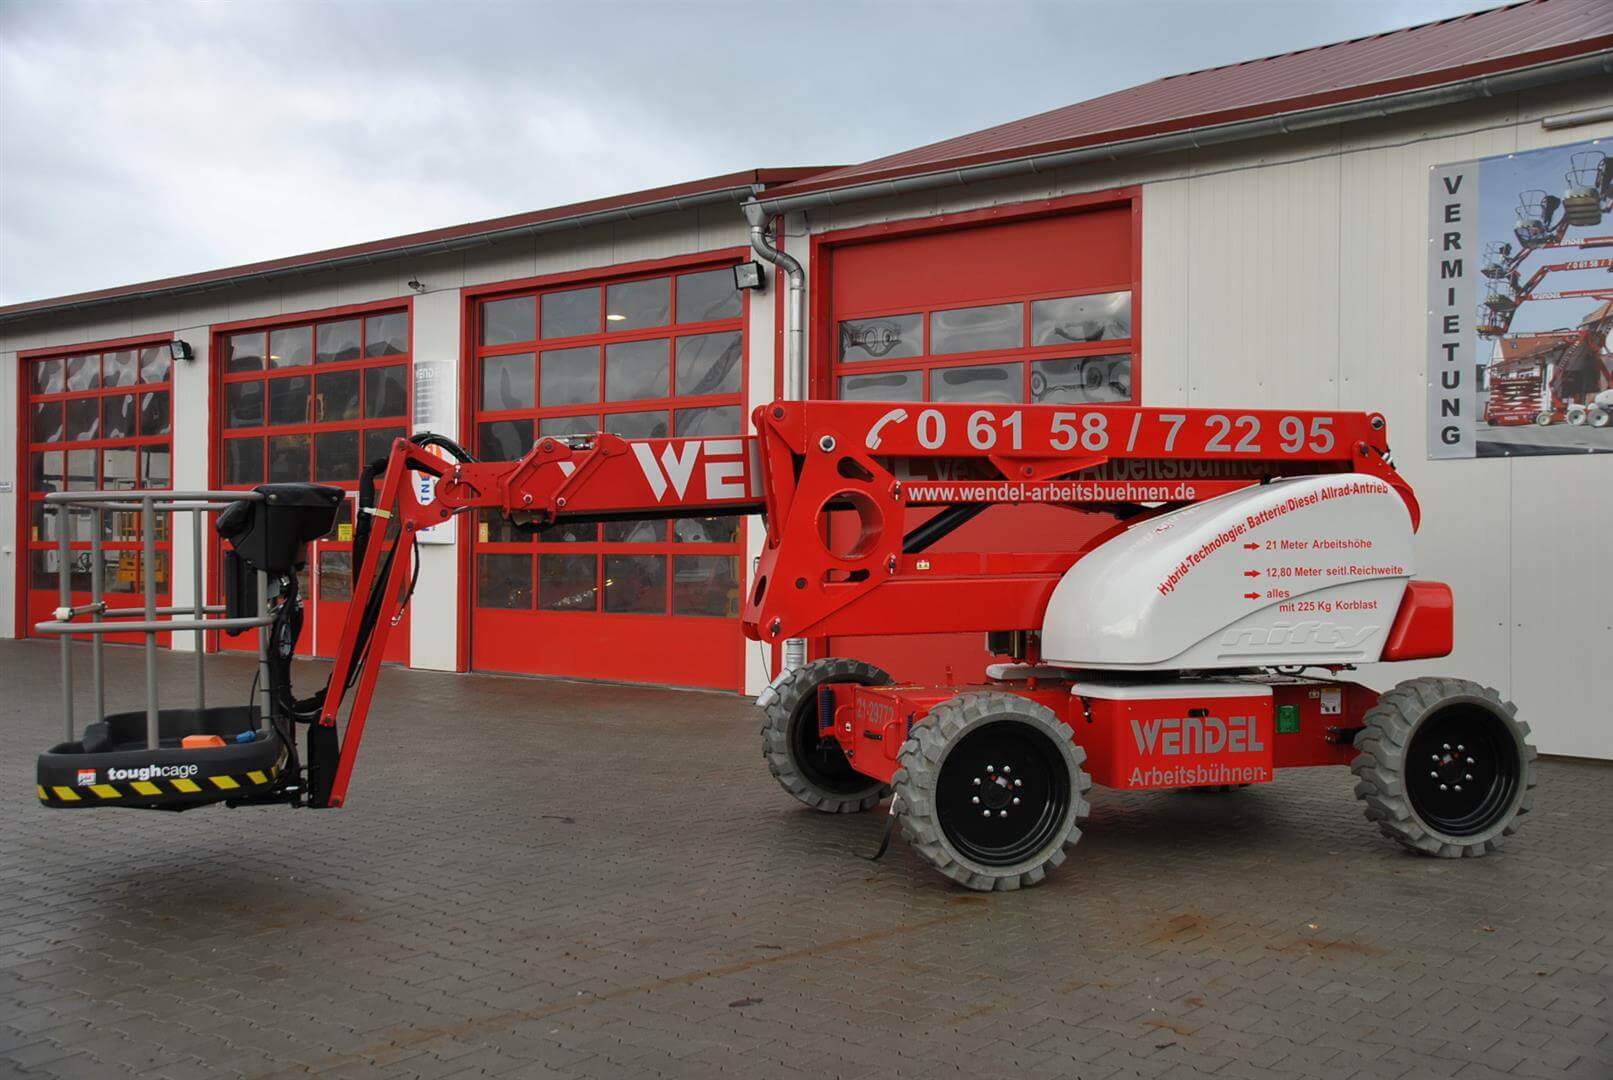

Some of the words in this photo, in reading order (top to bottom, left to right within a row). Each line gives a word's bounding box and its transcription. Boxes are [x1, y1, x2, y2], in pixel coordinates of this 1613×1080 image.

[1441, 175, 1463, 445] VERMIETUNG
[916, 409, 946, 449] 0
[967, 410, 1022, 450] 61
[1050, 412, 1109, 451] 58
[1126, 412, 1142, 452] /
[1159, 414, 1186, 452] 7
[1204, 415, 1261, 452] 22
[1278, 416, 1335, 454] 95
[908, 483, 1196, 502] www.wendel-arbeitsbuehnen.de
[1247, 491, 1319, 529] Batterie/Diesel
[1321, 481, 1389, 501] Allrad-Antrieb
[1266, 540, 1278, 550] 21
[1280, 540, 1308, 550] Meter
[1312, 538, 1372, 549] Arbeitshöhe
[1266, 567, 1292, 580] 12,80
[1294, 566, 1322, 577] Meter
[1266, 588, 1290, 599] alles
[1279, 602, 1295, 612] mit
[1297, 602, 1315, 612] 225
[1318, 602, 1332, 613] Kg
[1335, 600, 1377, 611] Korblast
[1130, 716, 1265, 756] WENDEL
[107, 764, 199, 781] toughcage
[1130, 763, 1265, 786] Arbeitsbühnen
